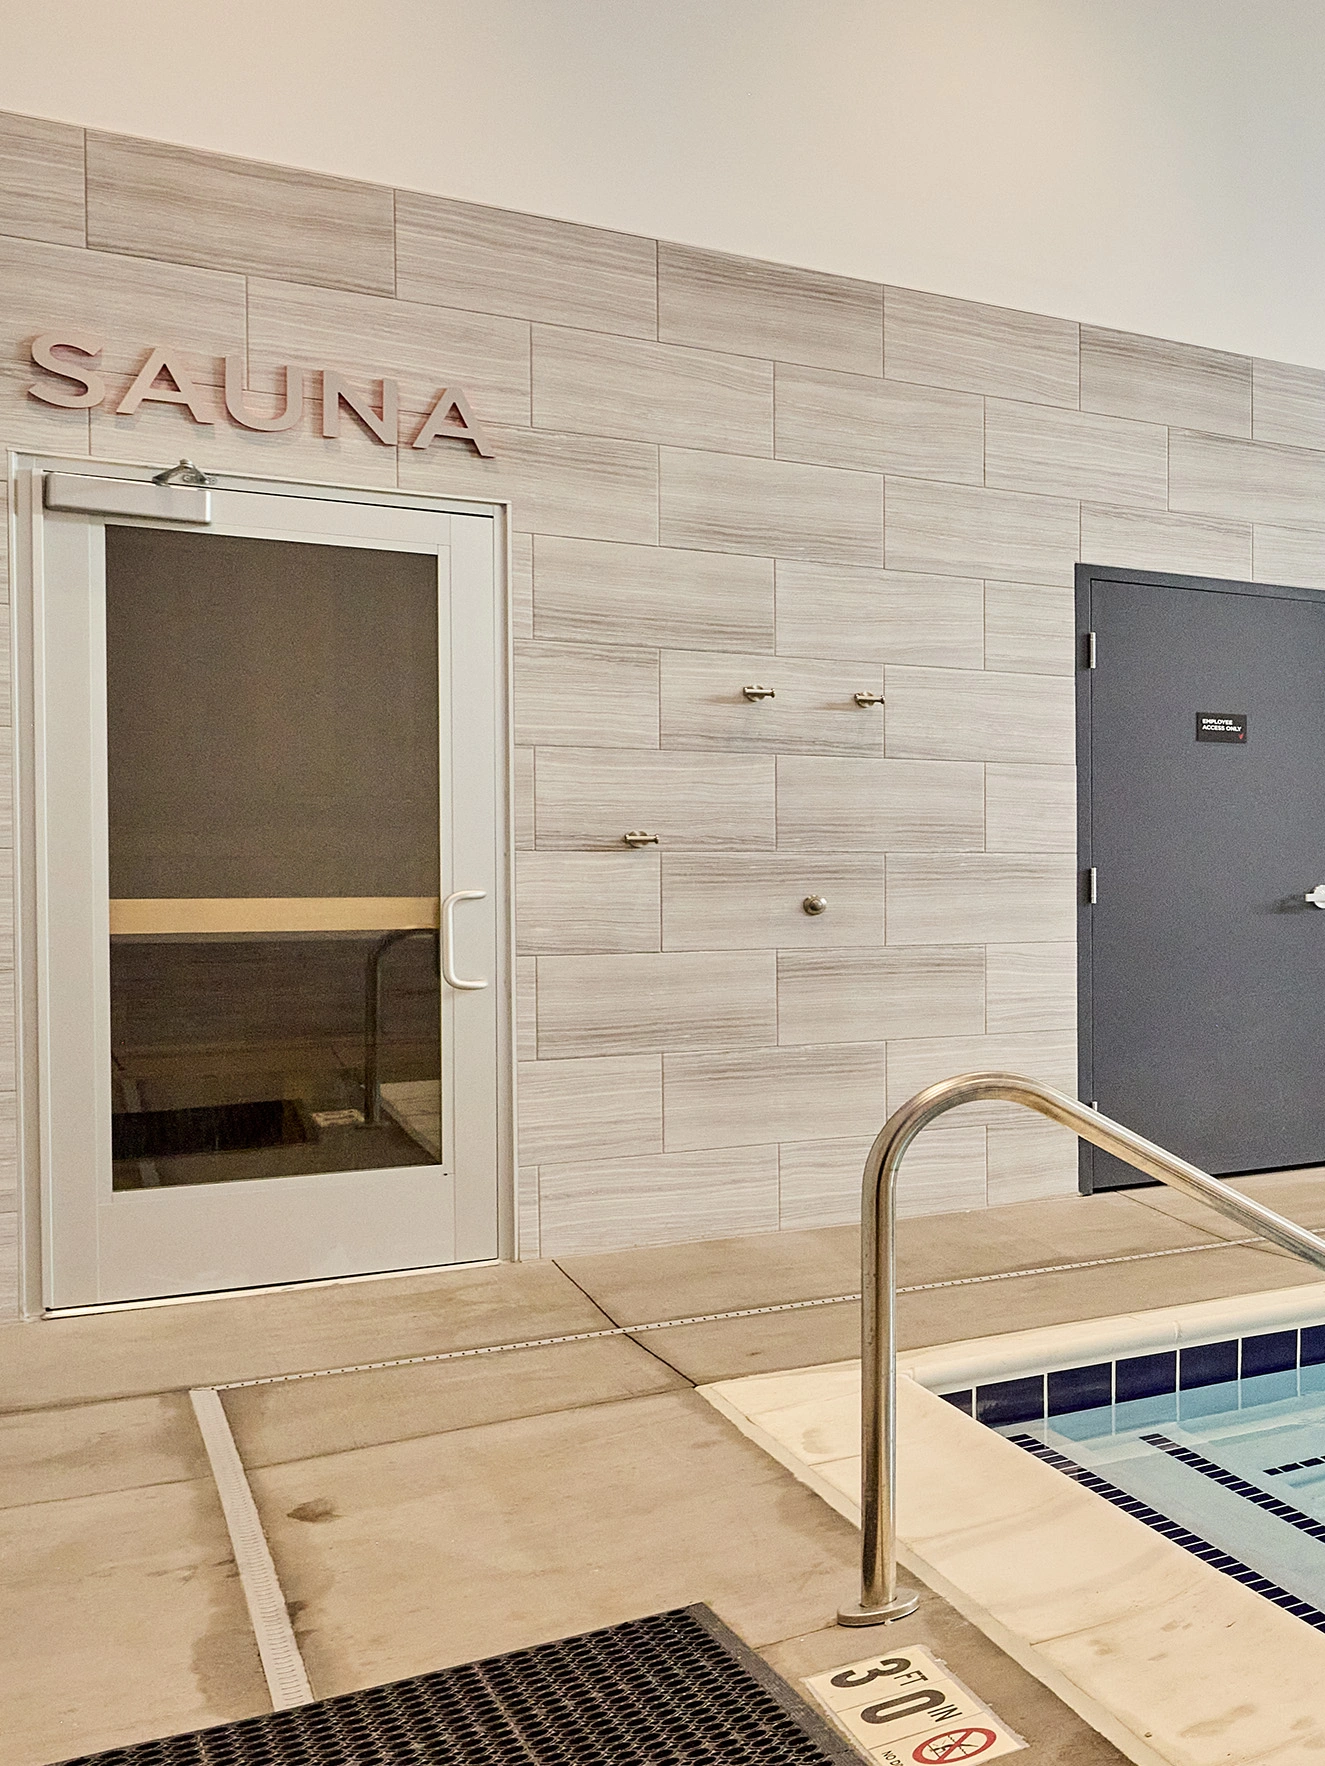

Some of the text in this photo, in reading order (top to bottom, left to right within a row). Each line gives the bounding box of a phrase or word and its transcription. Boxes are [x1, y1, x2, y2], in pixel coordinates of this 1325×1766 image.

[28, 332, 495, 458] SAUNA
[830, 1658, 962, 1724] 3 FT 0 IN
